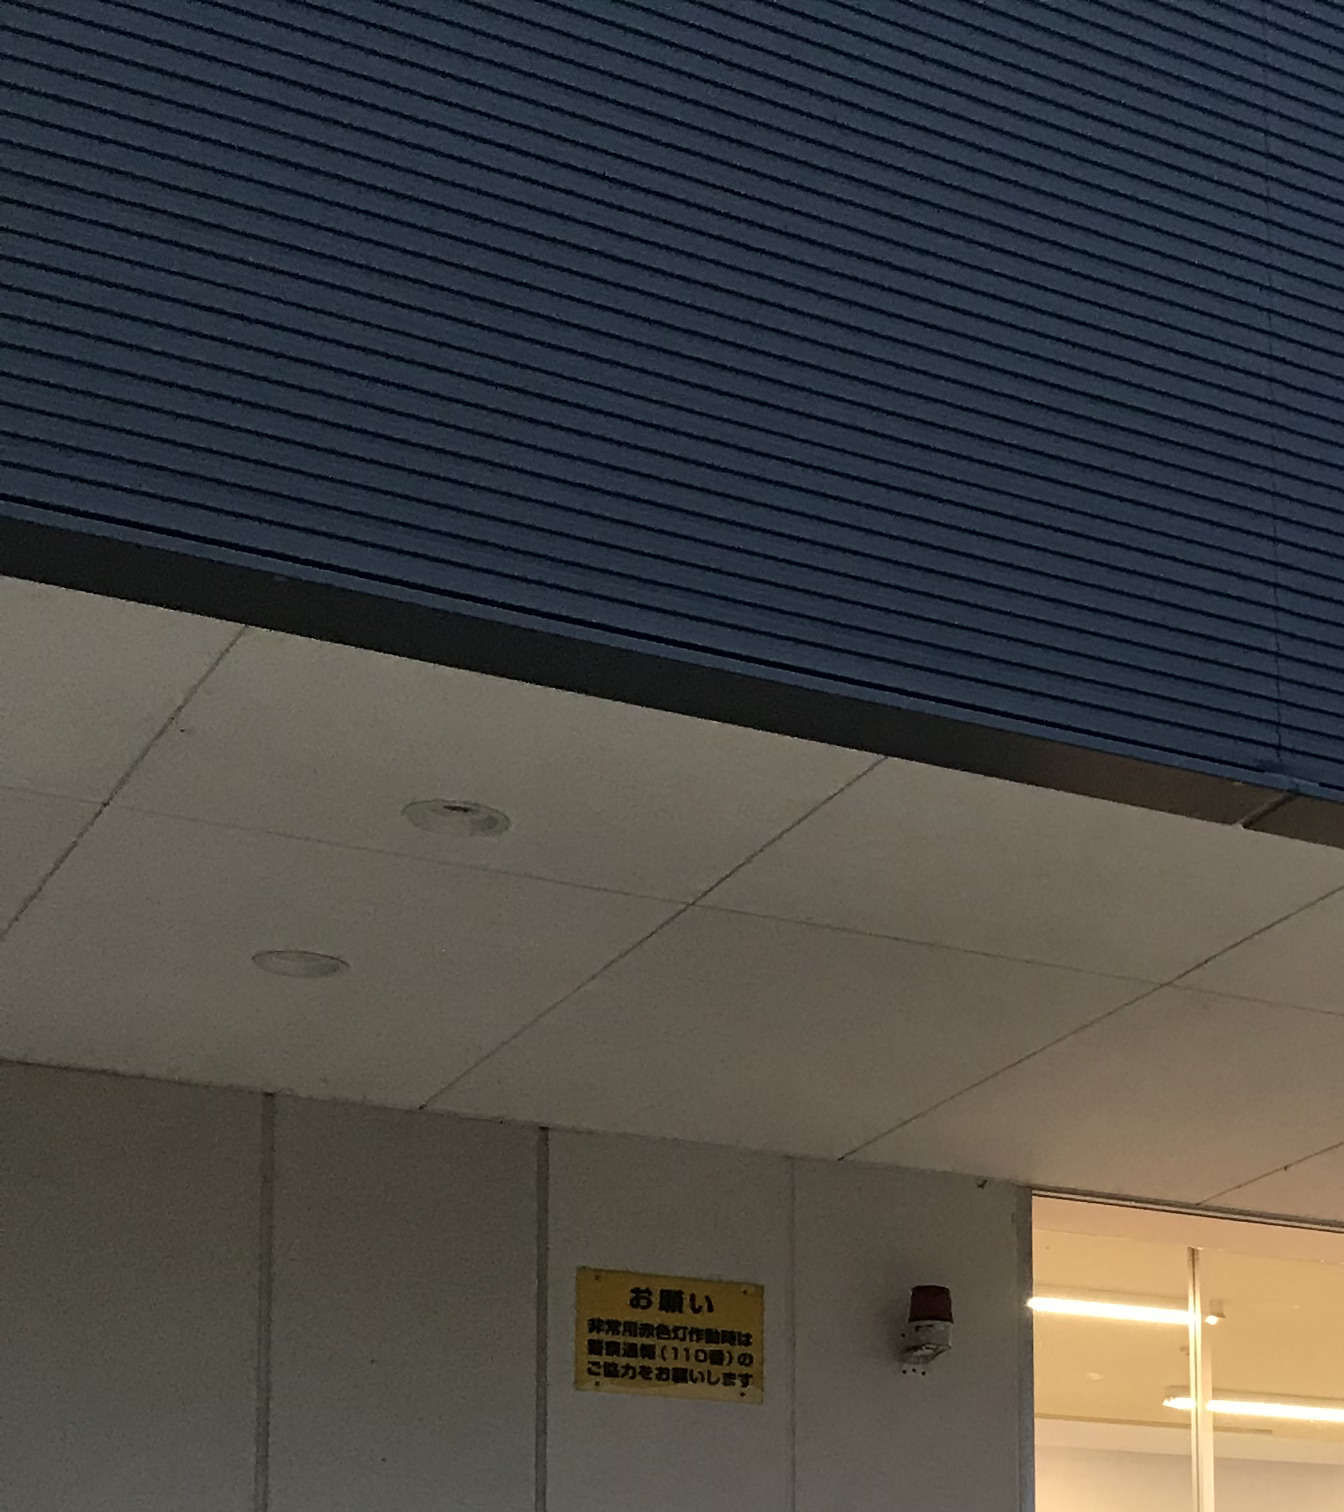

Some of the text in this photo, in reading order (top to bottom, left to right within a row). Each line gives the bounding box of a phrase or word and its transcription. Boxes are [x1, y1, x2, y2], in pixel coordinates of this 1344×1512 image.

[630, 1287, 714, 1314] お願い
[587, 1318, 753, 1347] 非常用赤色灯作動時は
[587, 1360, 753, 1388] ご協力をお願いします
